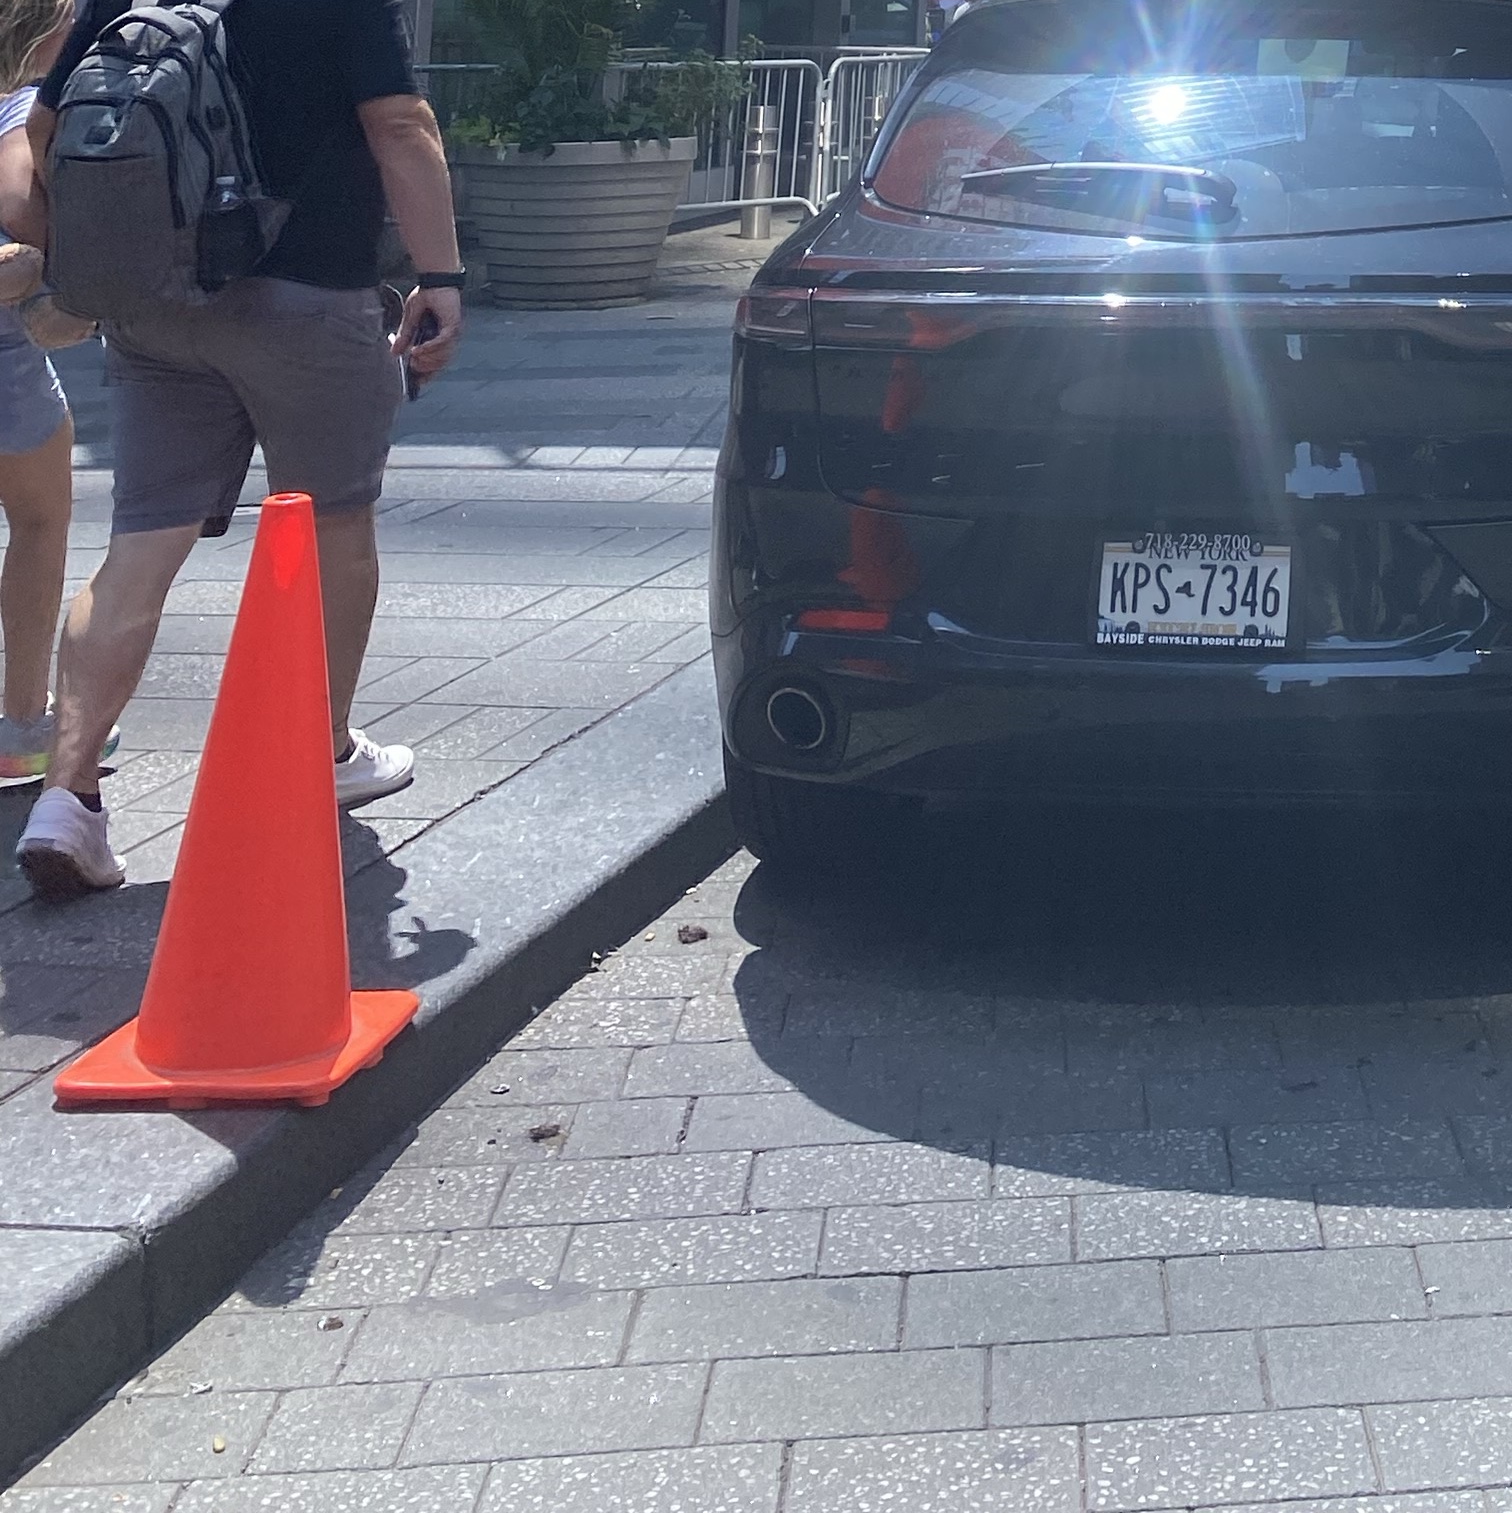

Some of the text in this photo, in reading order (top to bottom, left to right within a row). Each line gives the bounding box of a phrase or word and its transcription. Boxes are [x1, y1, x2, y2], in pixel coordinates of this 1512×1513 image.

[1145, 532, 1250, 551] 718-229-8700
[1110, 562, 1280, 618] KPS 7346
[1097, 632, 1286, 648] BAYSIDE CHRYSLER DODGE JEEP RAM
